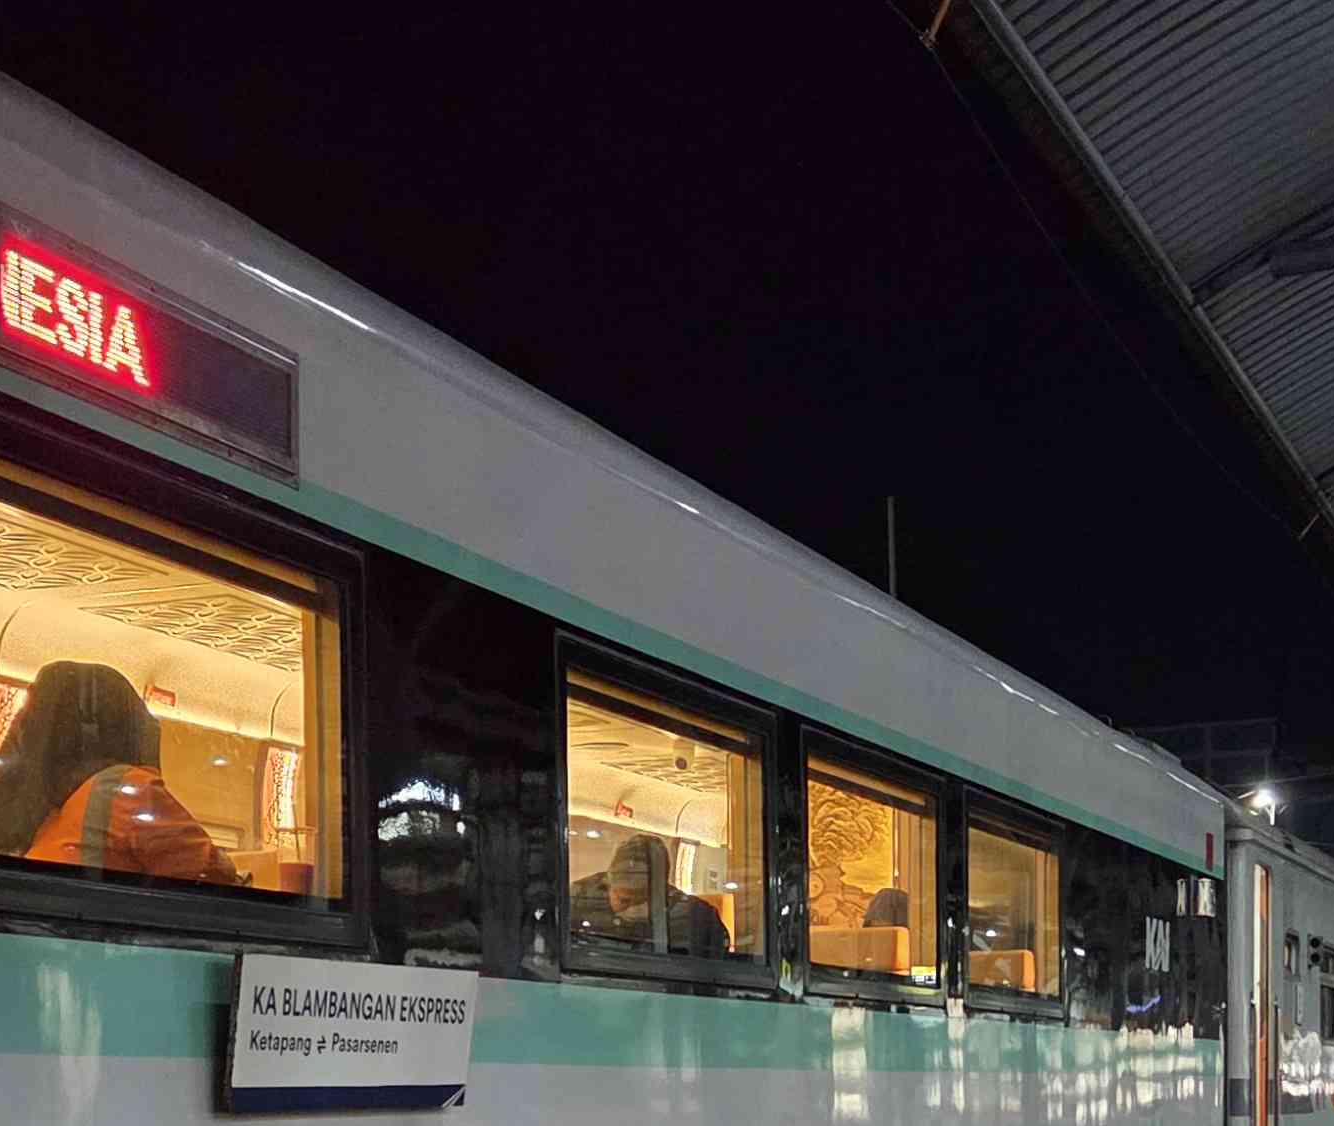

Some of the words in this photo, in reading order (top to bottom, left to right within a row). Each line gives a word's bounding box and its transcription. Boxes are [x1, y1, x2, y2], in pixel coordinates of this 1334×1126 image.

[252, 985, 277, 1016] KA
[282, 987, 396, 1022] BLAMBANGAN
[399, 996, 466, 1025] EKSPRESS
[250, 1030, 312, 1056] Ketapang
[331, 1032, 399, 1054] Pasarsenen
